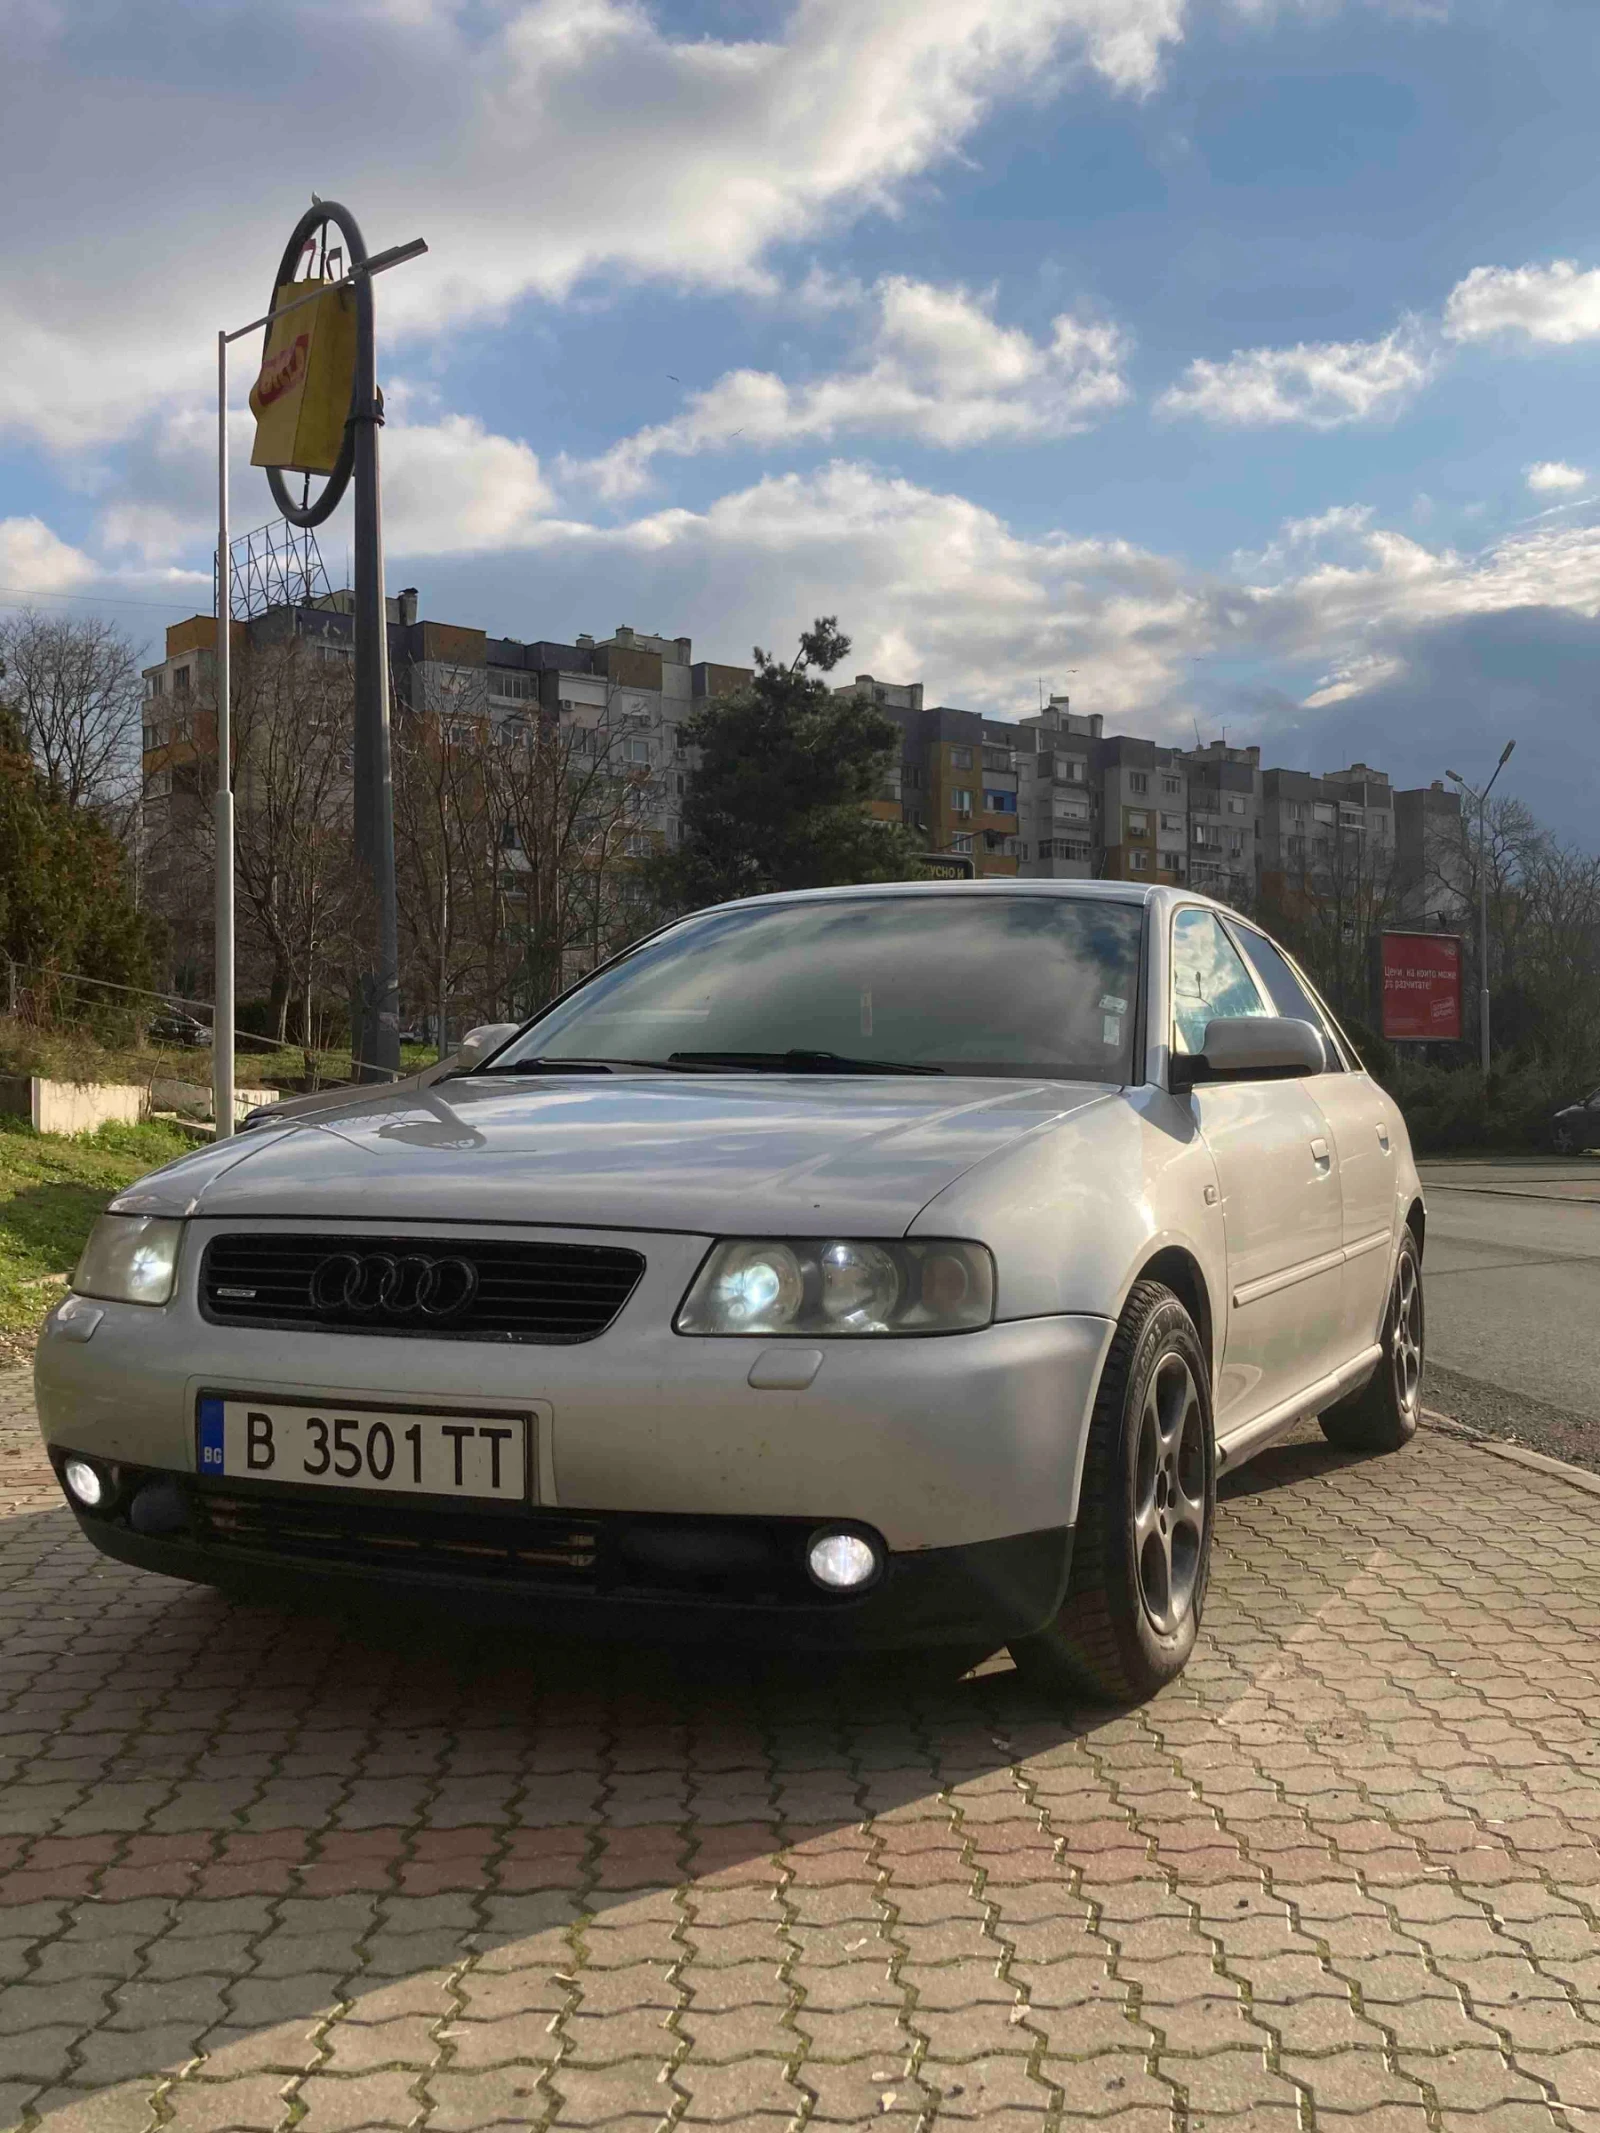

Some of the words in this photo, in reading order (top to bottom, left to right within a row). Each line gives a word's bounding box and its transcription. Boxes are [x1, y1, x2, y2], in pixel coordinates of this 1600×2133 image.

[203, 1446, 222, 1464] BG
[247, 1411, 275, 1470] B
[303, 1416, 422, 1484] 3501
[441, 1424, 513, 1489] TT
